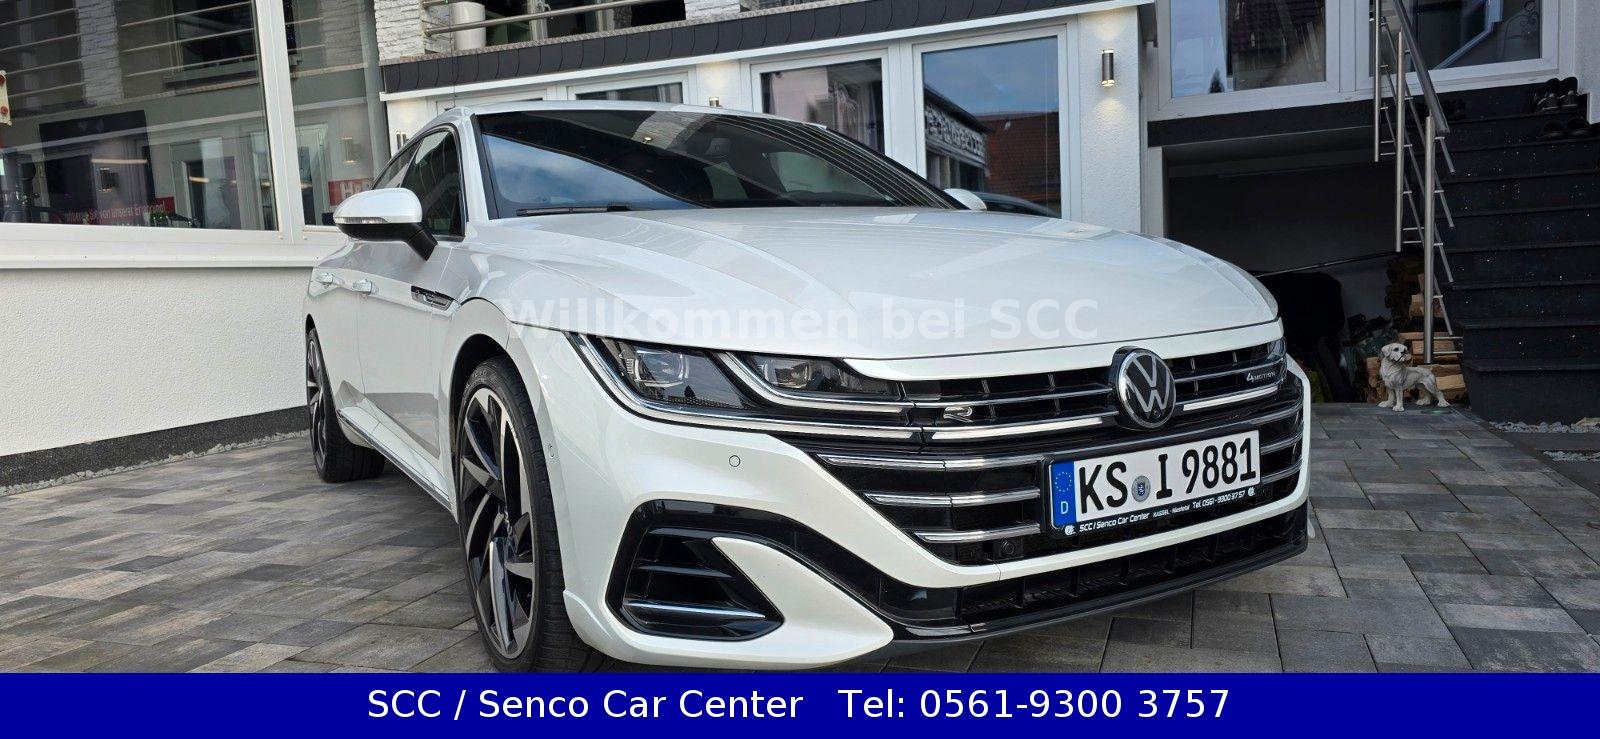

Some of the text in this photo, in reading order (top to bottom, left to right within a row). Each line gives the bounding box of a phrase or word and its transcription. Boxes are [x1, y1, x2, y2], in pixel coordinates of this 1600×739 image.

[1079, 437, 1256, 514] KS I 9881
[1060, 501, 1069, 515] D
[1117, 517, 1128, 526] Car
